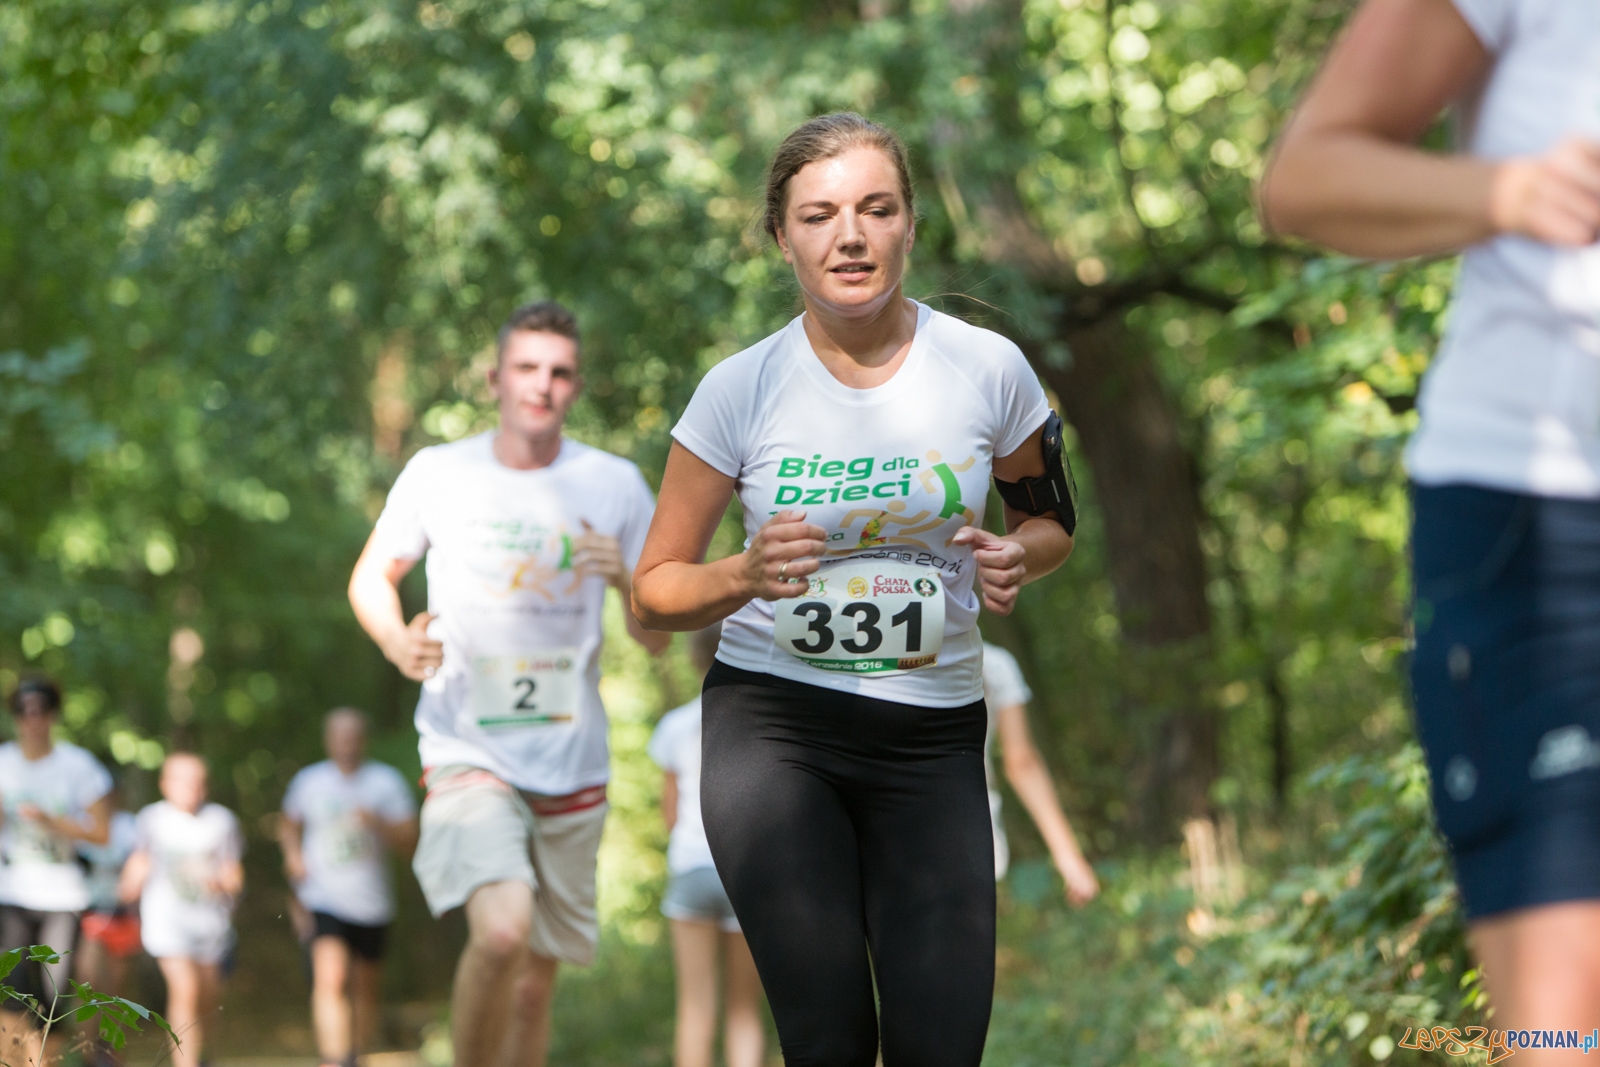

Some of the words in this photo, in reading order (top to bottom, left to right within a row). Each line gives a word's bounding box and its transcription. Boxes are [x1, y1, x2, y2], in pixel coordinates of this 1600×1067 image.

[777, 453, 875, 481] Bieg
[882, 457, 919, 471] dla
[774, 473, 912, 505] Dzieci
[872, 585, 914, 597] POLSKA
[874, 575, 910, 587] CHATA
[791, 601, 923, 655] 331
[854, 661, 883, 670] 2016
[513, 677, 537, 710] 2
